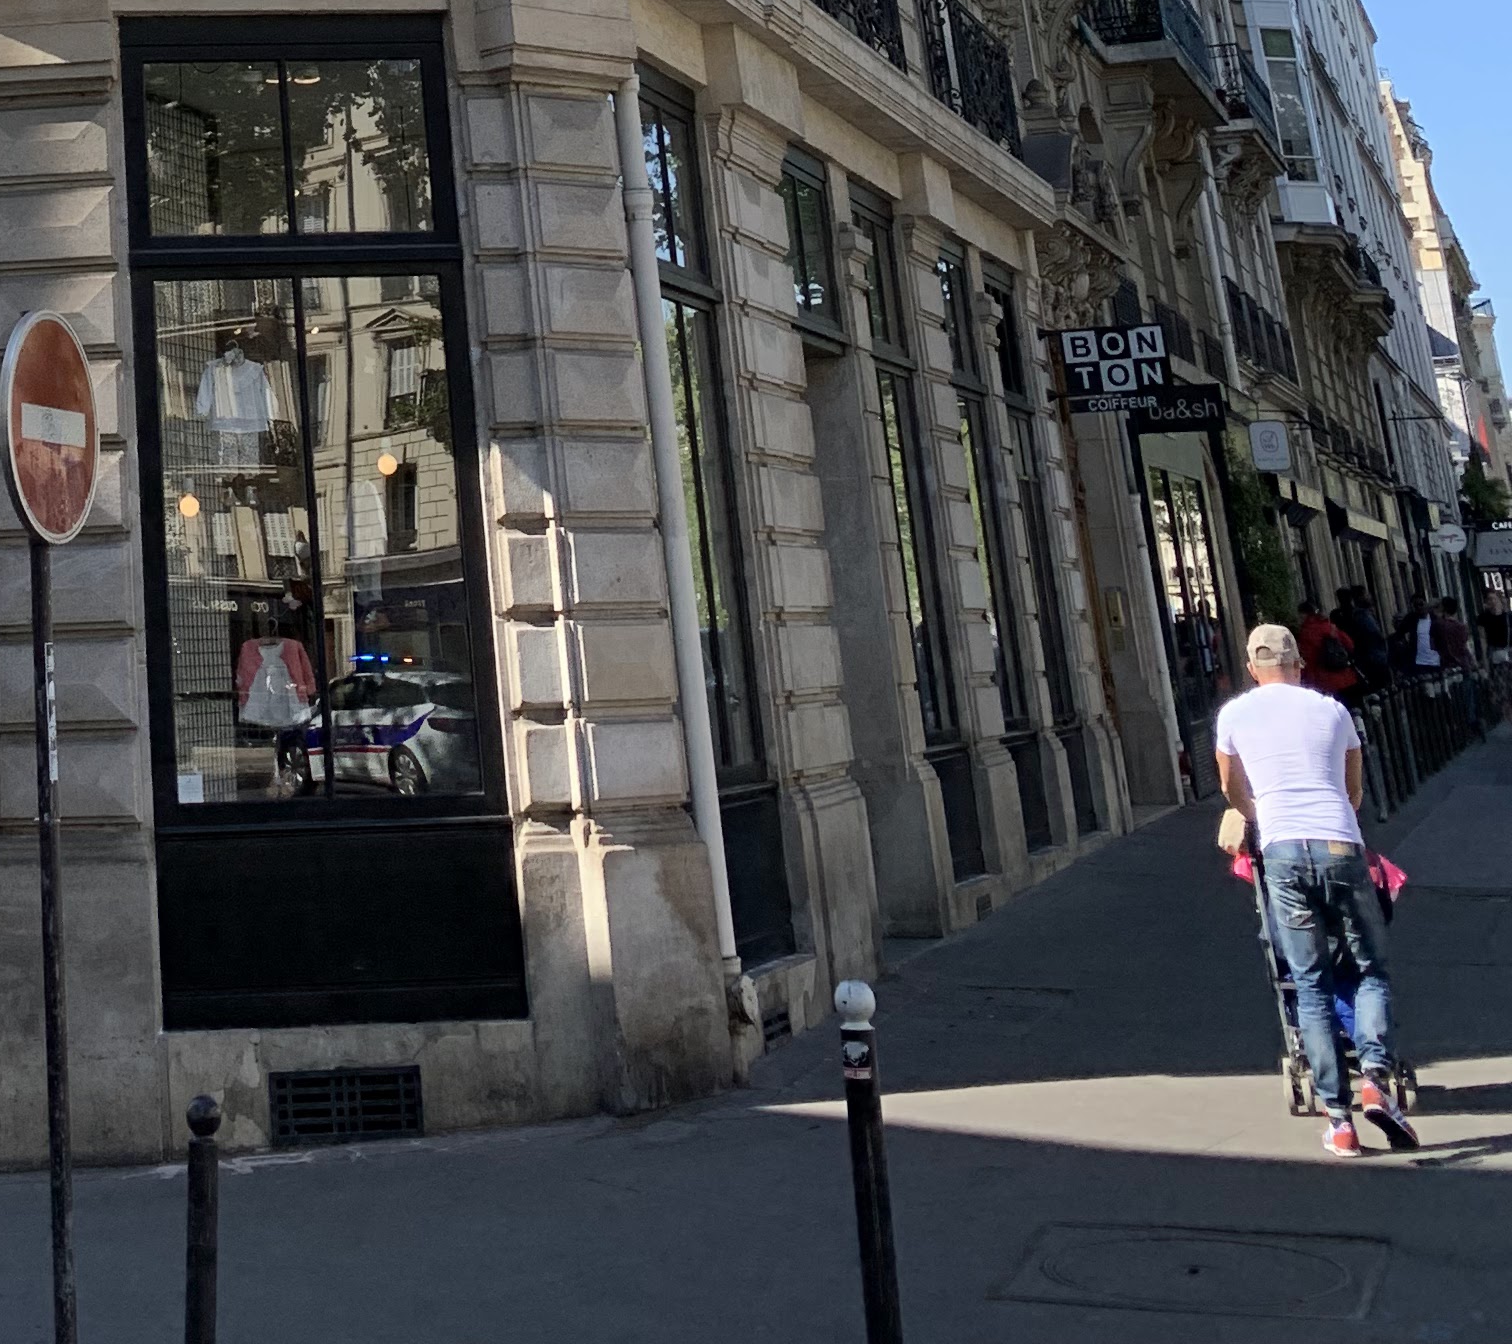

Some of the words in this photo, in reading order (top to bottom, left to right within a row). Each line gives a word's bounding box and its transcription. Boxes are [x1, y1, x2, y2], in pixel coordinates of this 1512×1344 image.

[1069, 330, 1158, 358] BON
[1074, 361, 1164, 390] TON
[1088, 395, 1158, 412] COIFFEUR
